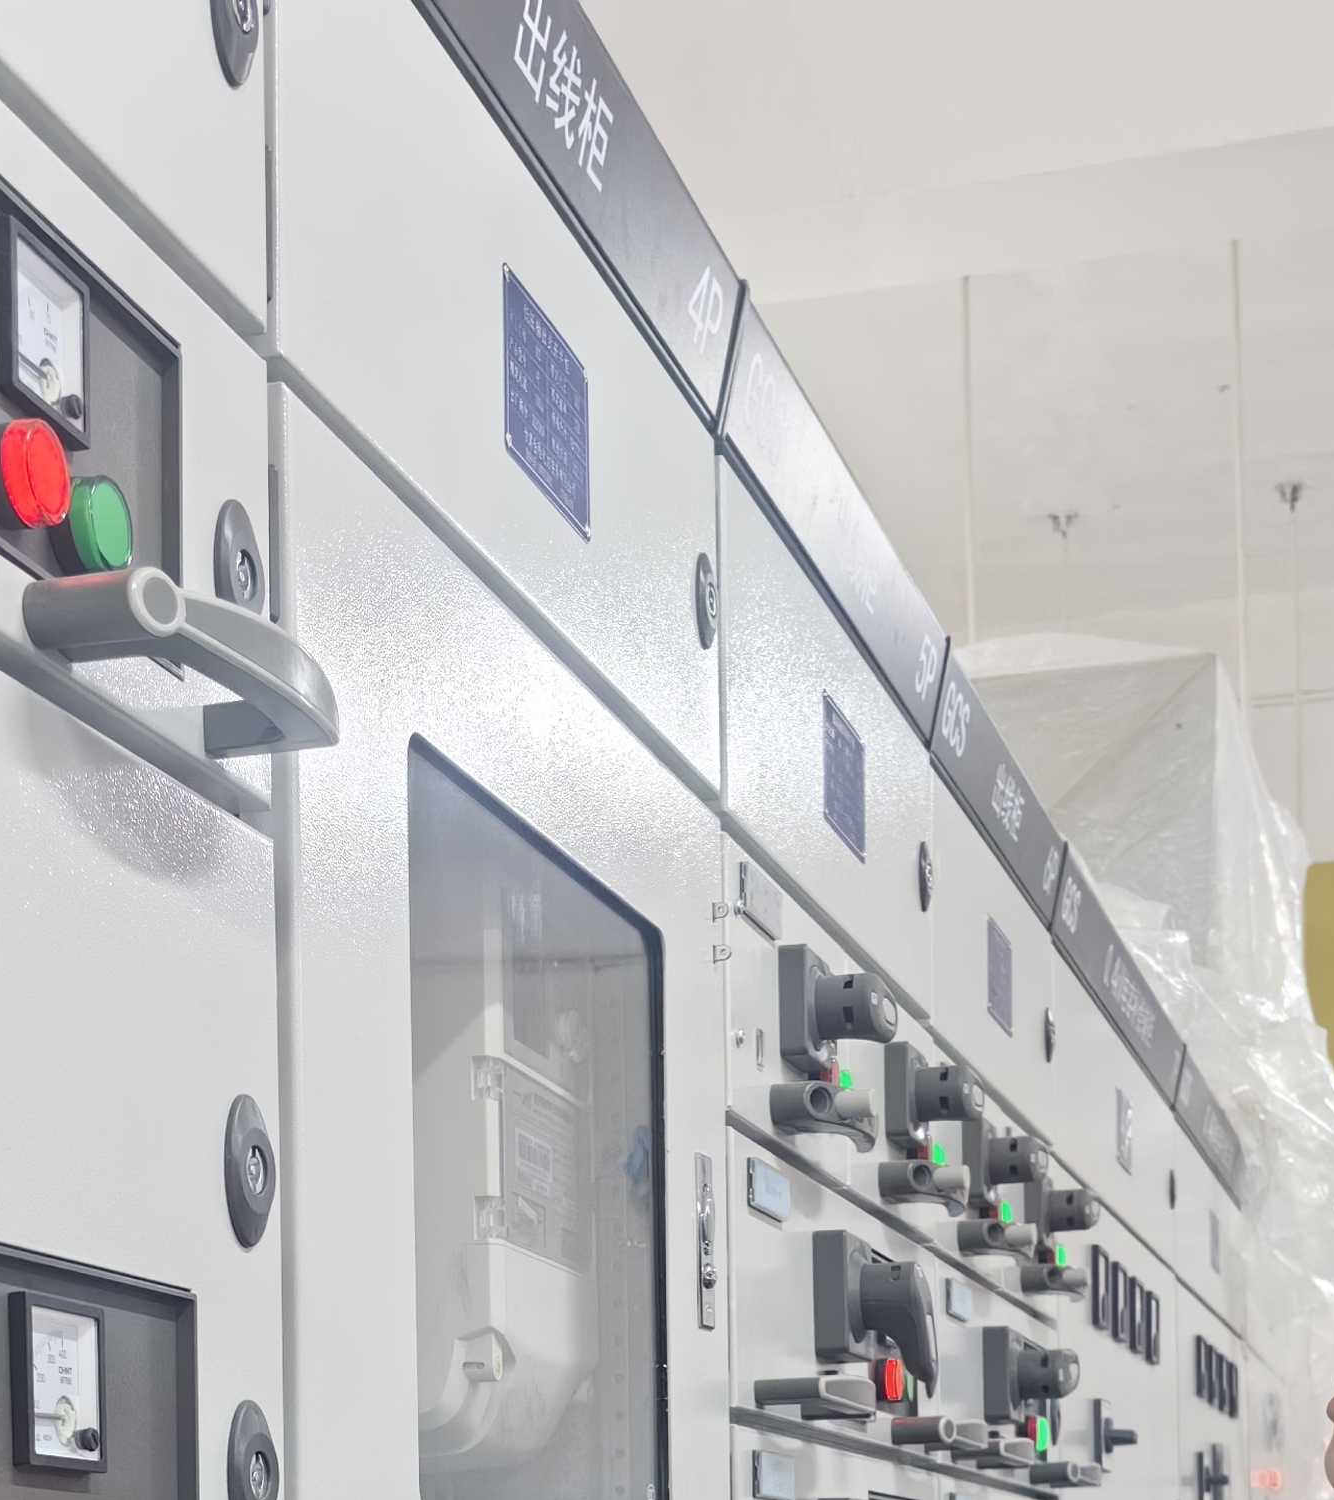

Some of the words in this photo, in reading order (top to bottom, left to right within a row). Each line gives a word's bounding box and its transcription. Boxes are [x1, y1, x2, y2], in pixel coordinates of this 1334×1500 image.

[514, 0, 614, 193] 出线柜
[687, 266, 724, 355] 4P
[915, 632, 938, 701] 5P
[941, 680, 971, 758] GCS
